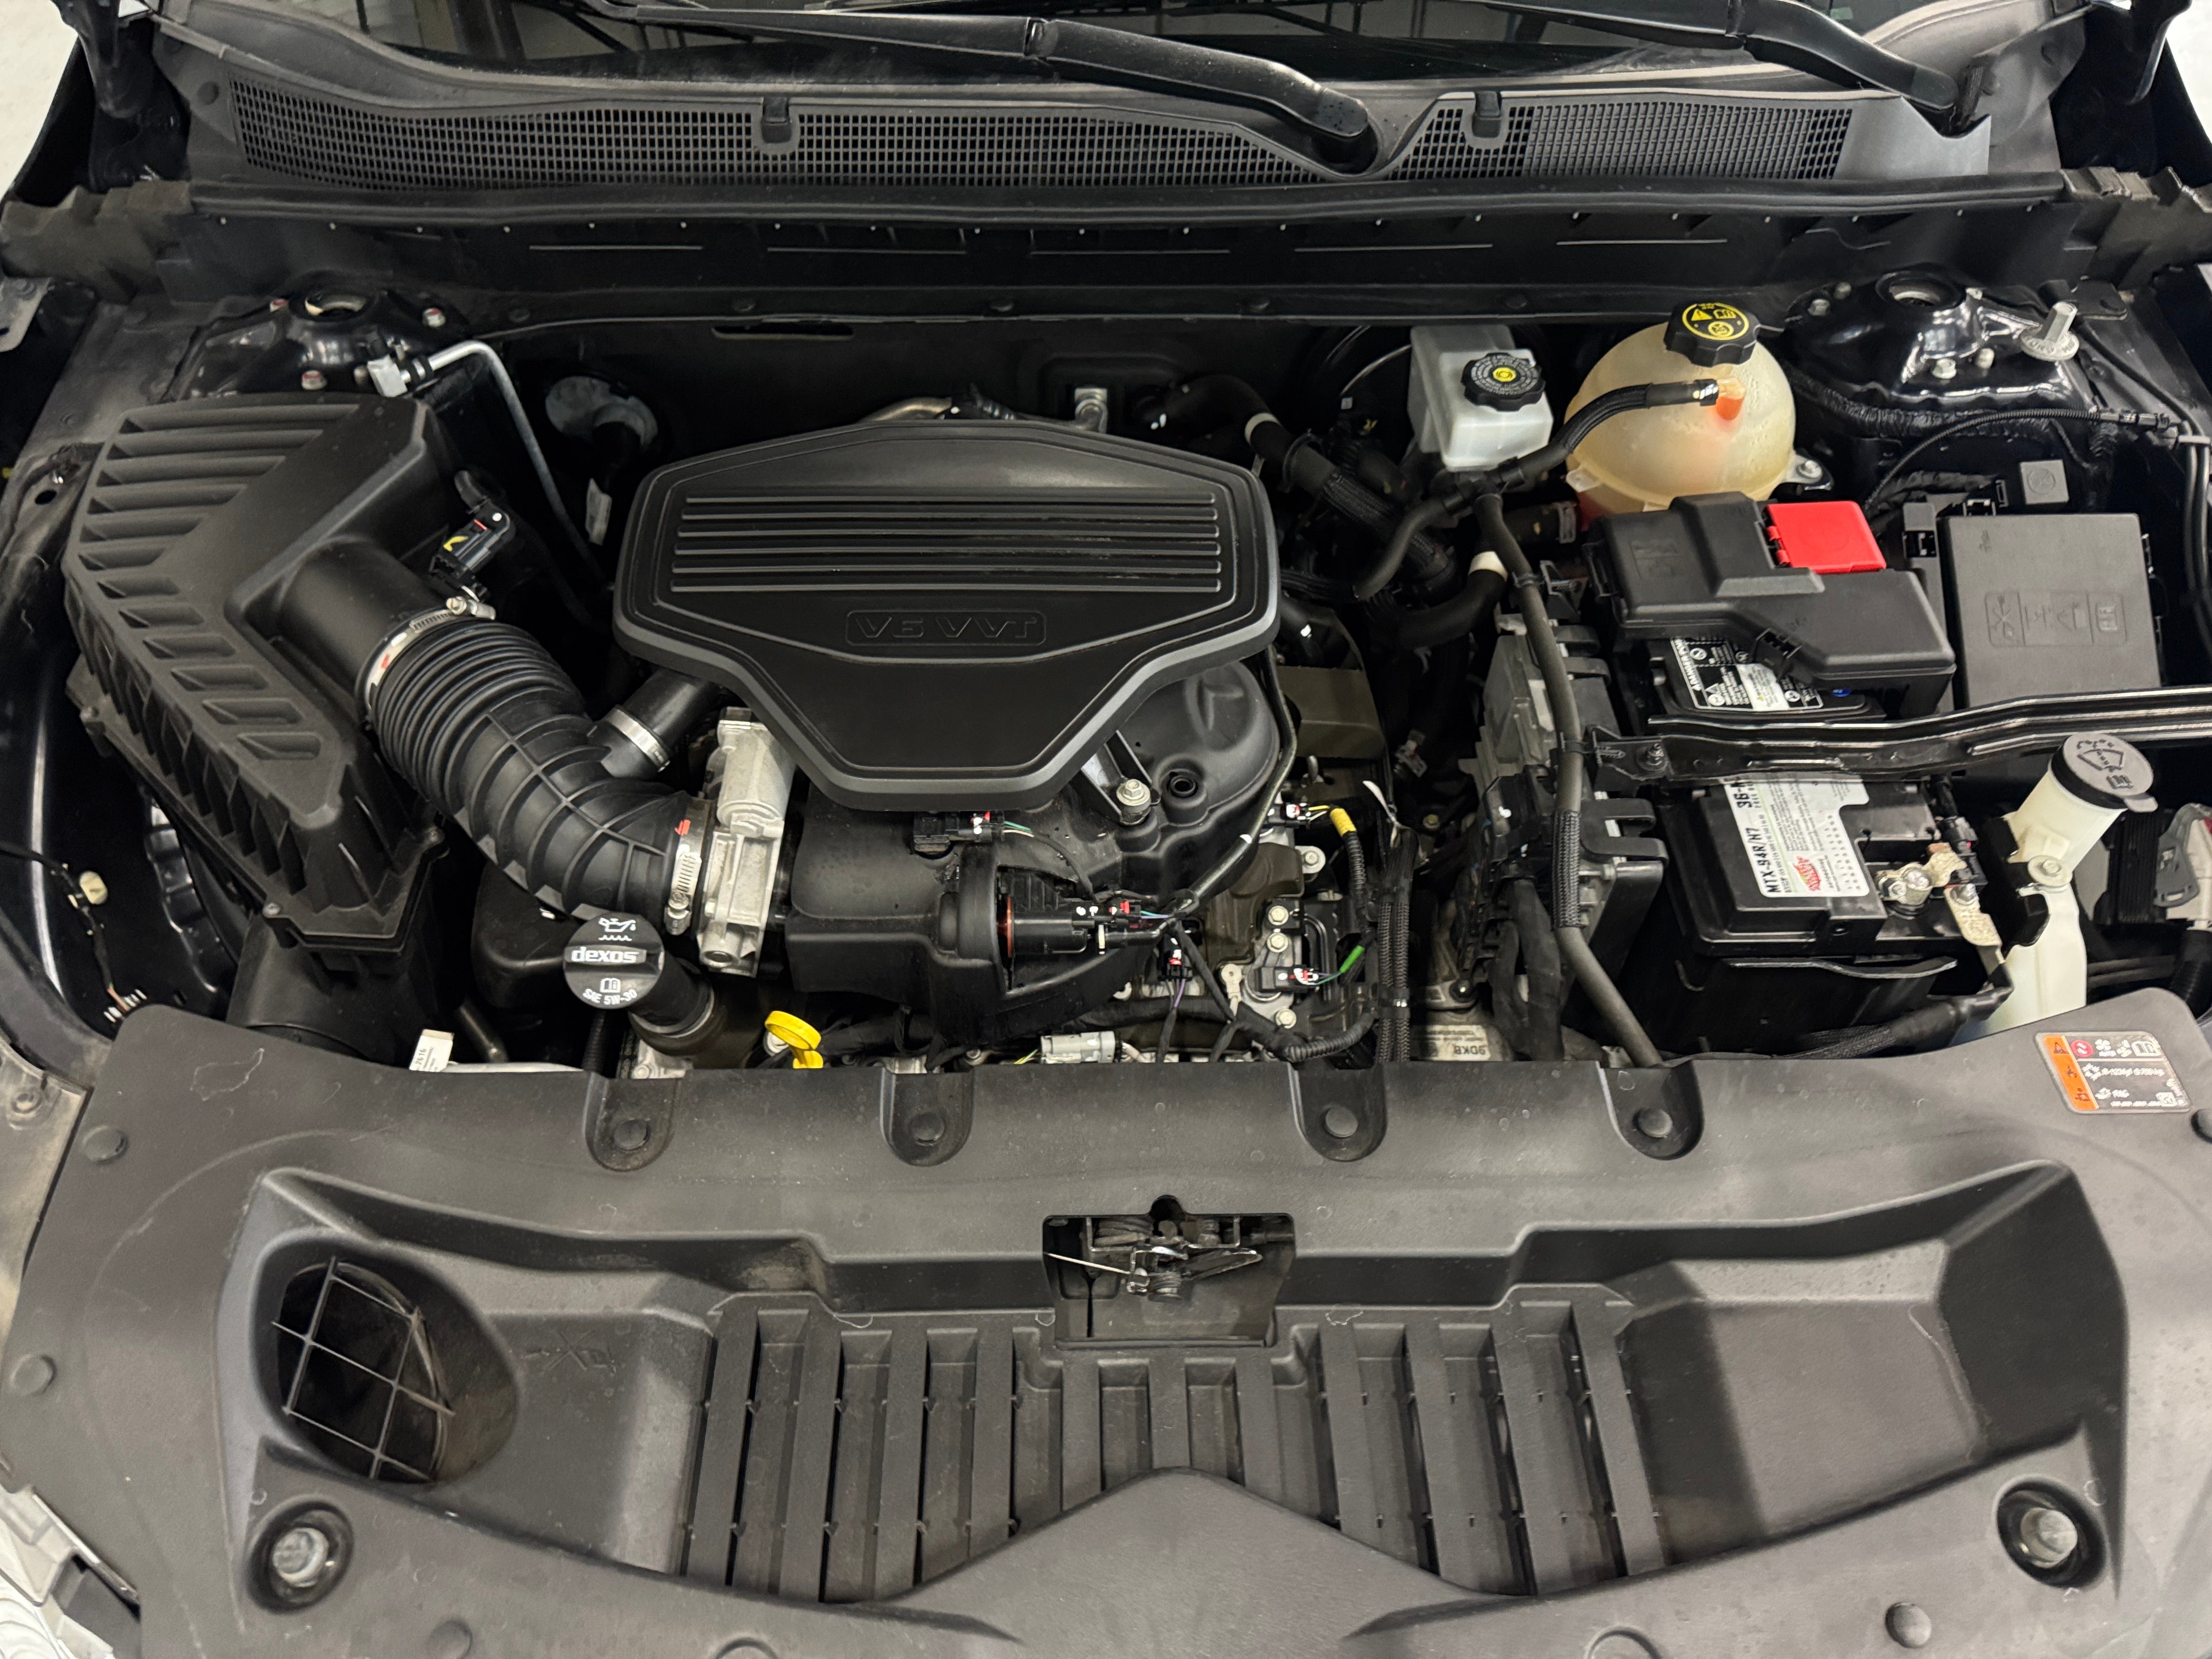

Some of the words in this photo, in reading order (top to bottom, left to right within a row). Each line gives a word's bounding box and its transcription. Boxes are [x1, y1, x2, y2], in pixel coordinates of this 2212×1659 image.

[935, 616, 1037, 639] VVT
[571, 946, 639, 963] dexos
[603, 989, 638, 1005] 5W-30
